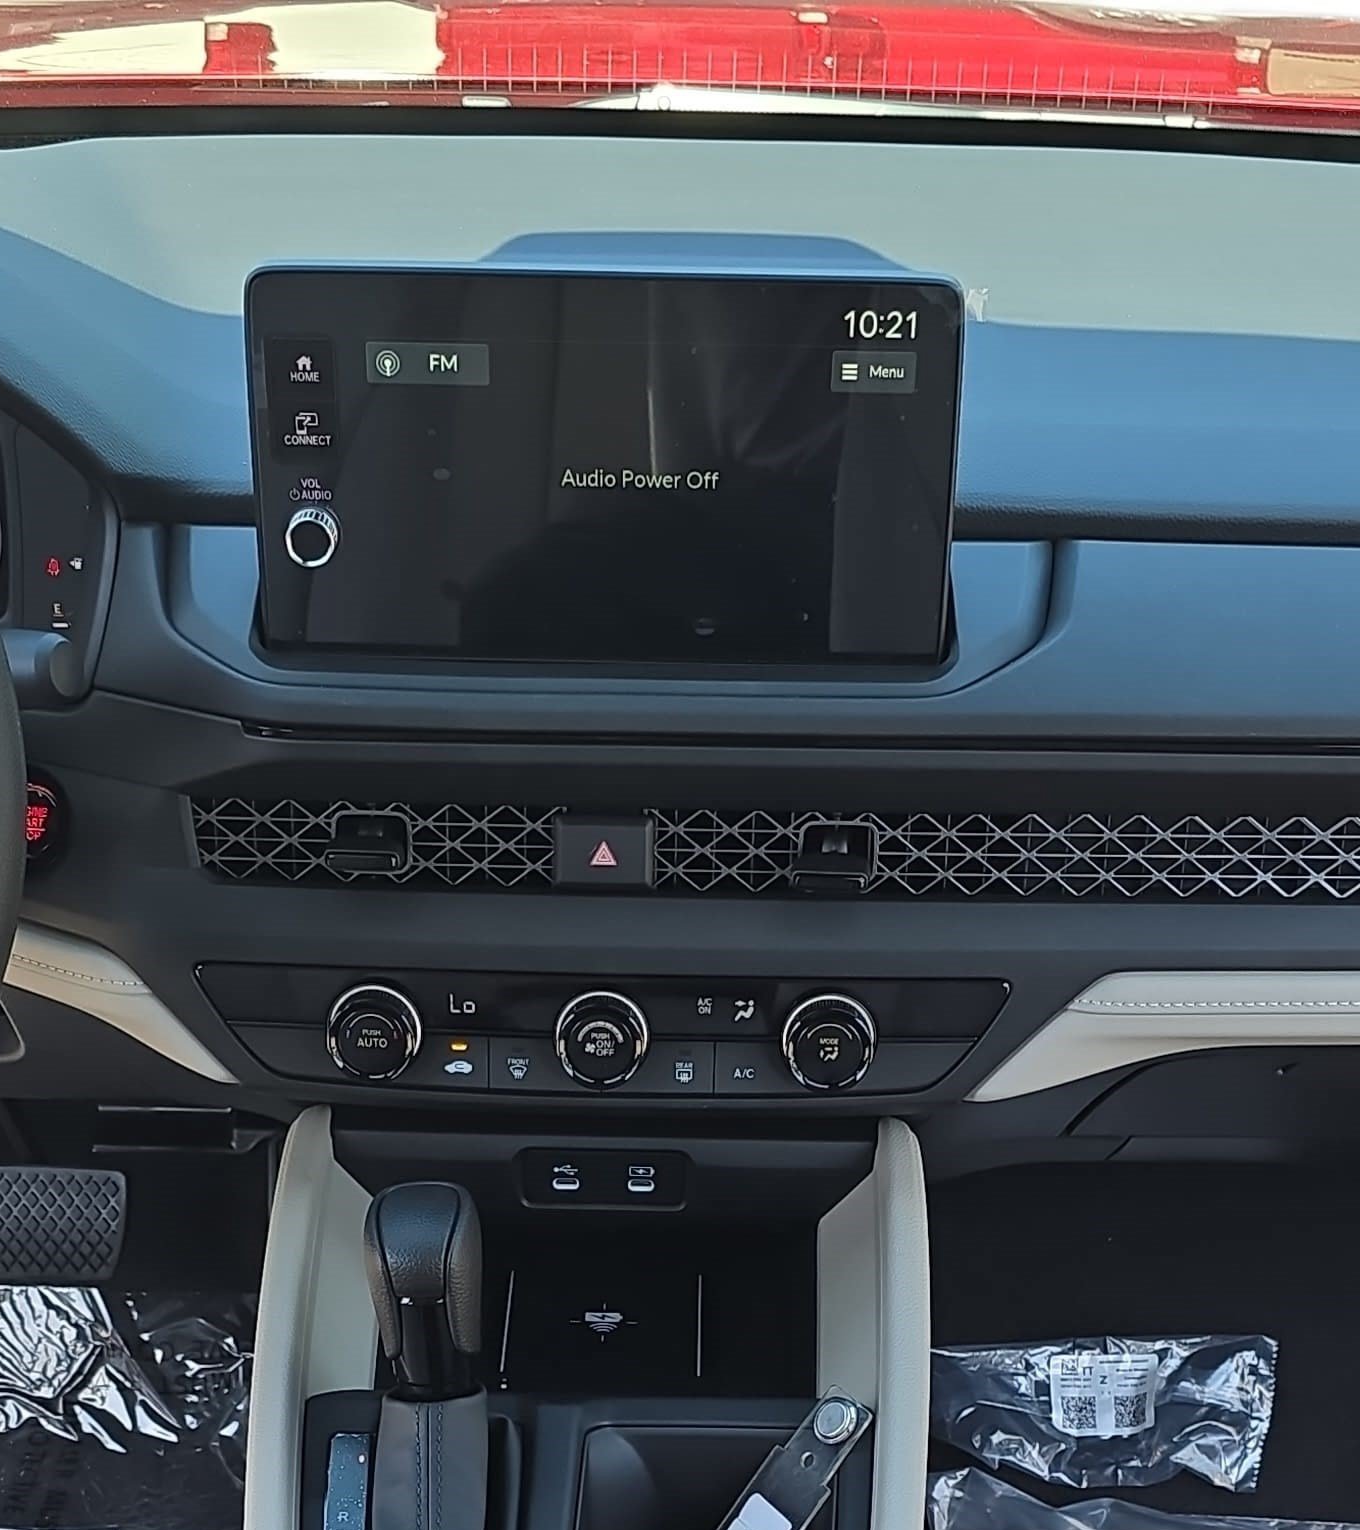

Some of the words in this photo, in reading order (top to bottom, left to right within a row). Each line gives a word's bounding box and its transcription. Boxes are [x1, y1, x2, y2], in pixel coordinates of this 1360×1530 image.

[844, 310, 917, 339] 10:21
[428, 355, 458, 371] FM
[290, 372, 320, 382] HOME
[869, 365, 904, 378] Menu
[284, 435, 331, 446] CONNECT
[301, 478, 320, 488] VOL
[561, 469, 616, 488] Audio
[622, 469, 681, 489] Power
[687, 469, 719, 490] Off
[302, 490, 331, 500] AUDIO
[53, 603, 61, 614] E
[698, 1006, 711, 1015] ON
[357, 1037, 388, 1048] AUTO
[596, 1048, 615, 1056] OFF
[734, 1069, 754, 1079] A/C
[340, 1511, 349, 1522] R
